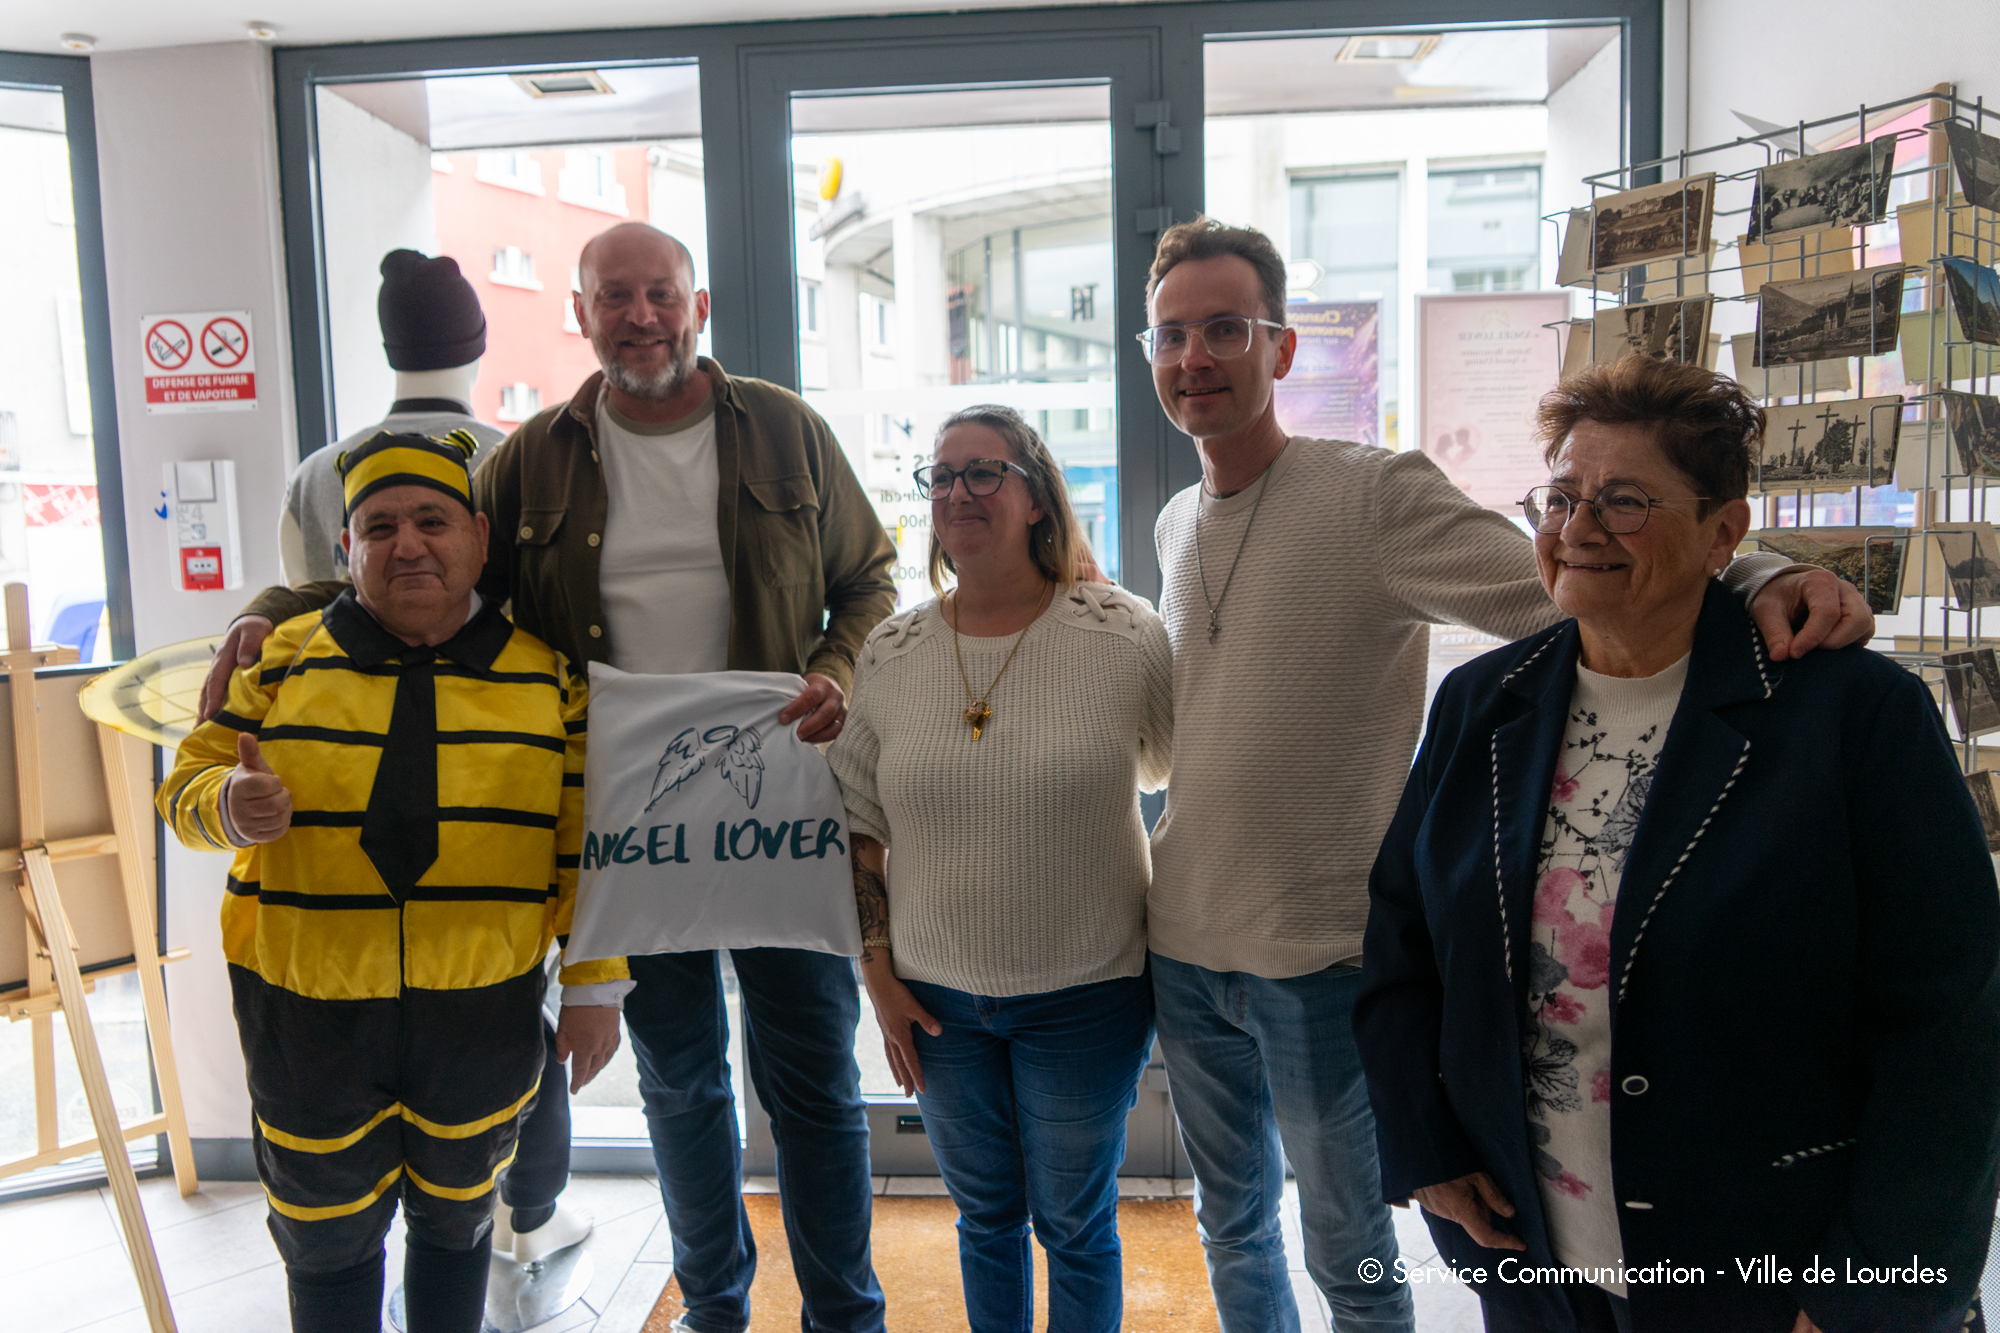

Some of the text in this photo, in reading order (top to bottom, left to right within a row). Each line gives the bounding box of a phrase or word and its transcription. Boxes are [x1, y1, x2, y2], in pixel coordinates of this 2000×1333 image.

[152, 373, 248, 390] DEFENSE DE FUMER
[163, 388, 238, 402] ET DE VAPOTER
[583, 818, 846, 870] ANGEL LOVER
